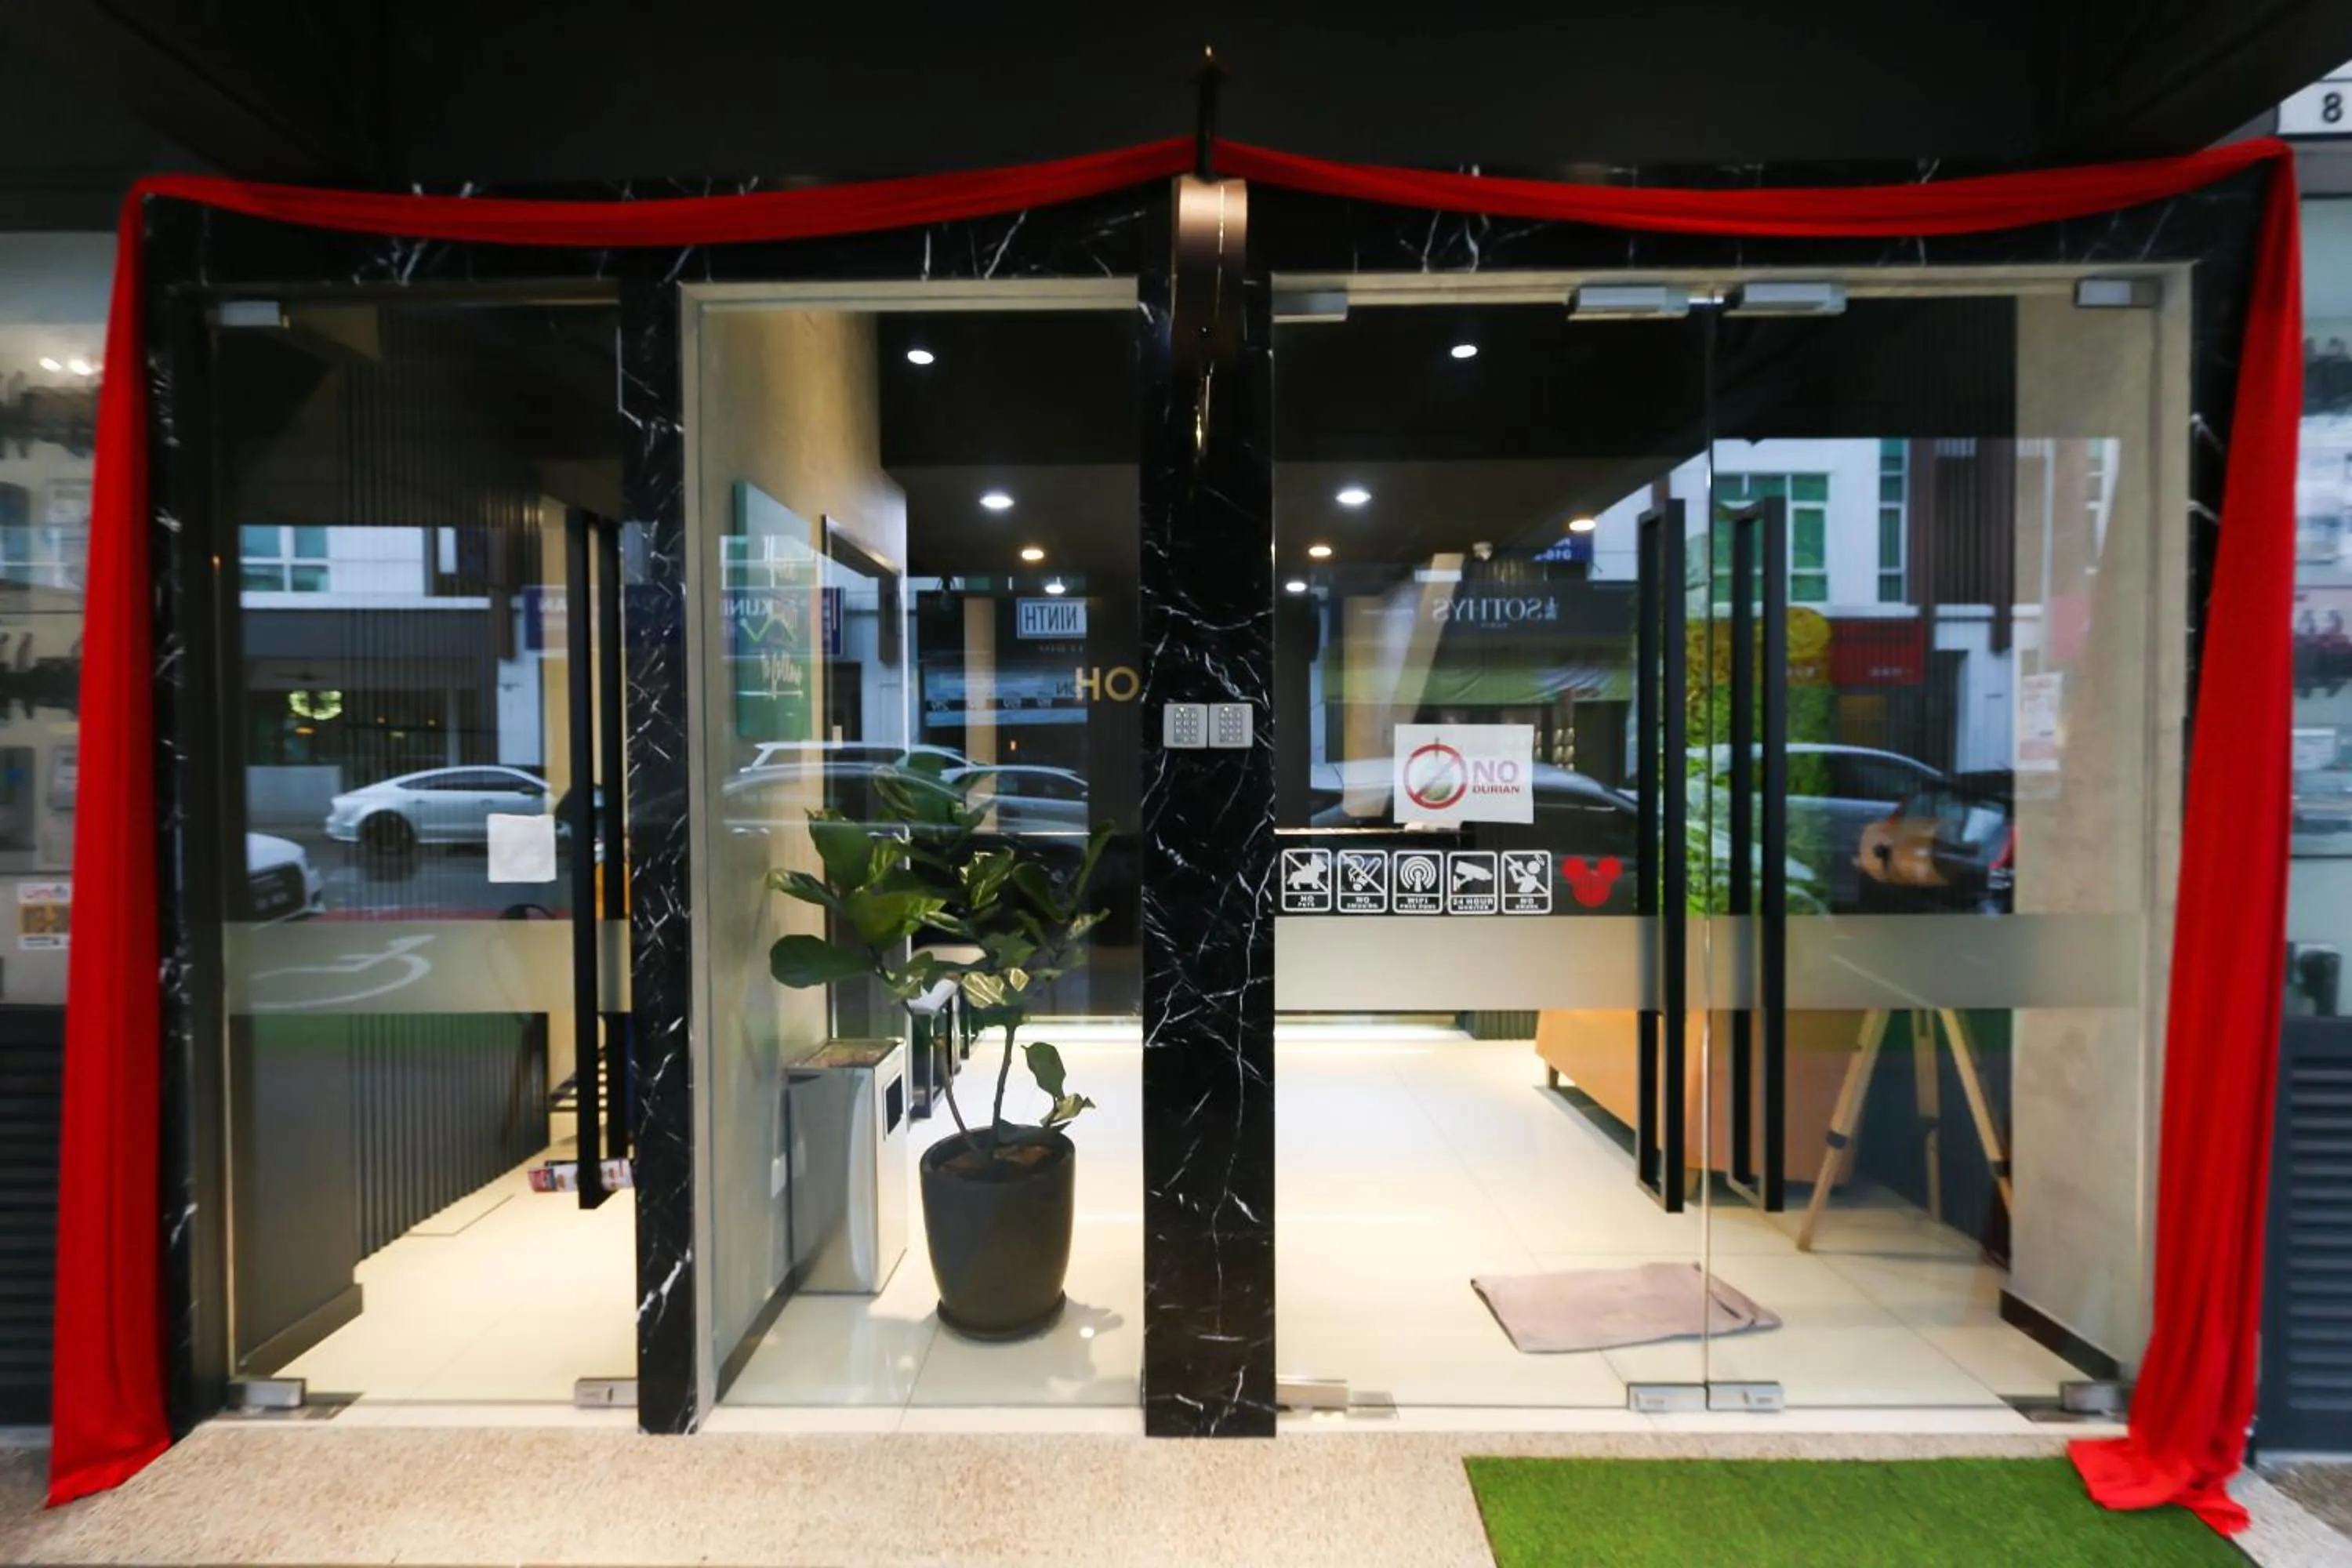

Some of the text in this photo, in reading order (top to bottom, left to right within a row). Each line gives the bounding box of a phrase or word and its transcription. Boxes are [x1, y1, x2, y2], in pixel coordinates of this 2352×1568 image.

[2321, 92, 2343, 123] 8
[1472, 760, 1519, 782] NO
[1472, 785, 1520, 794] DURIAN
